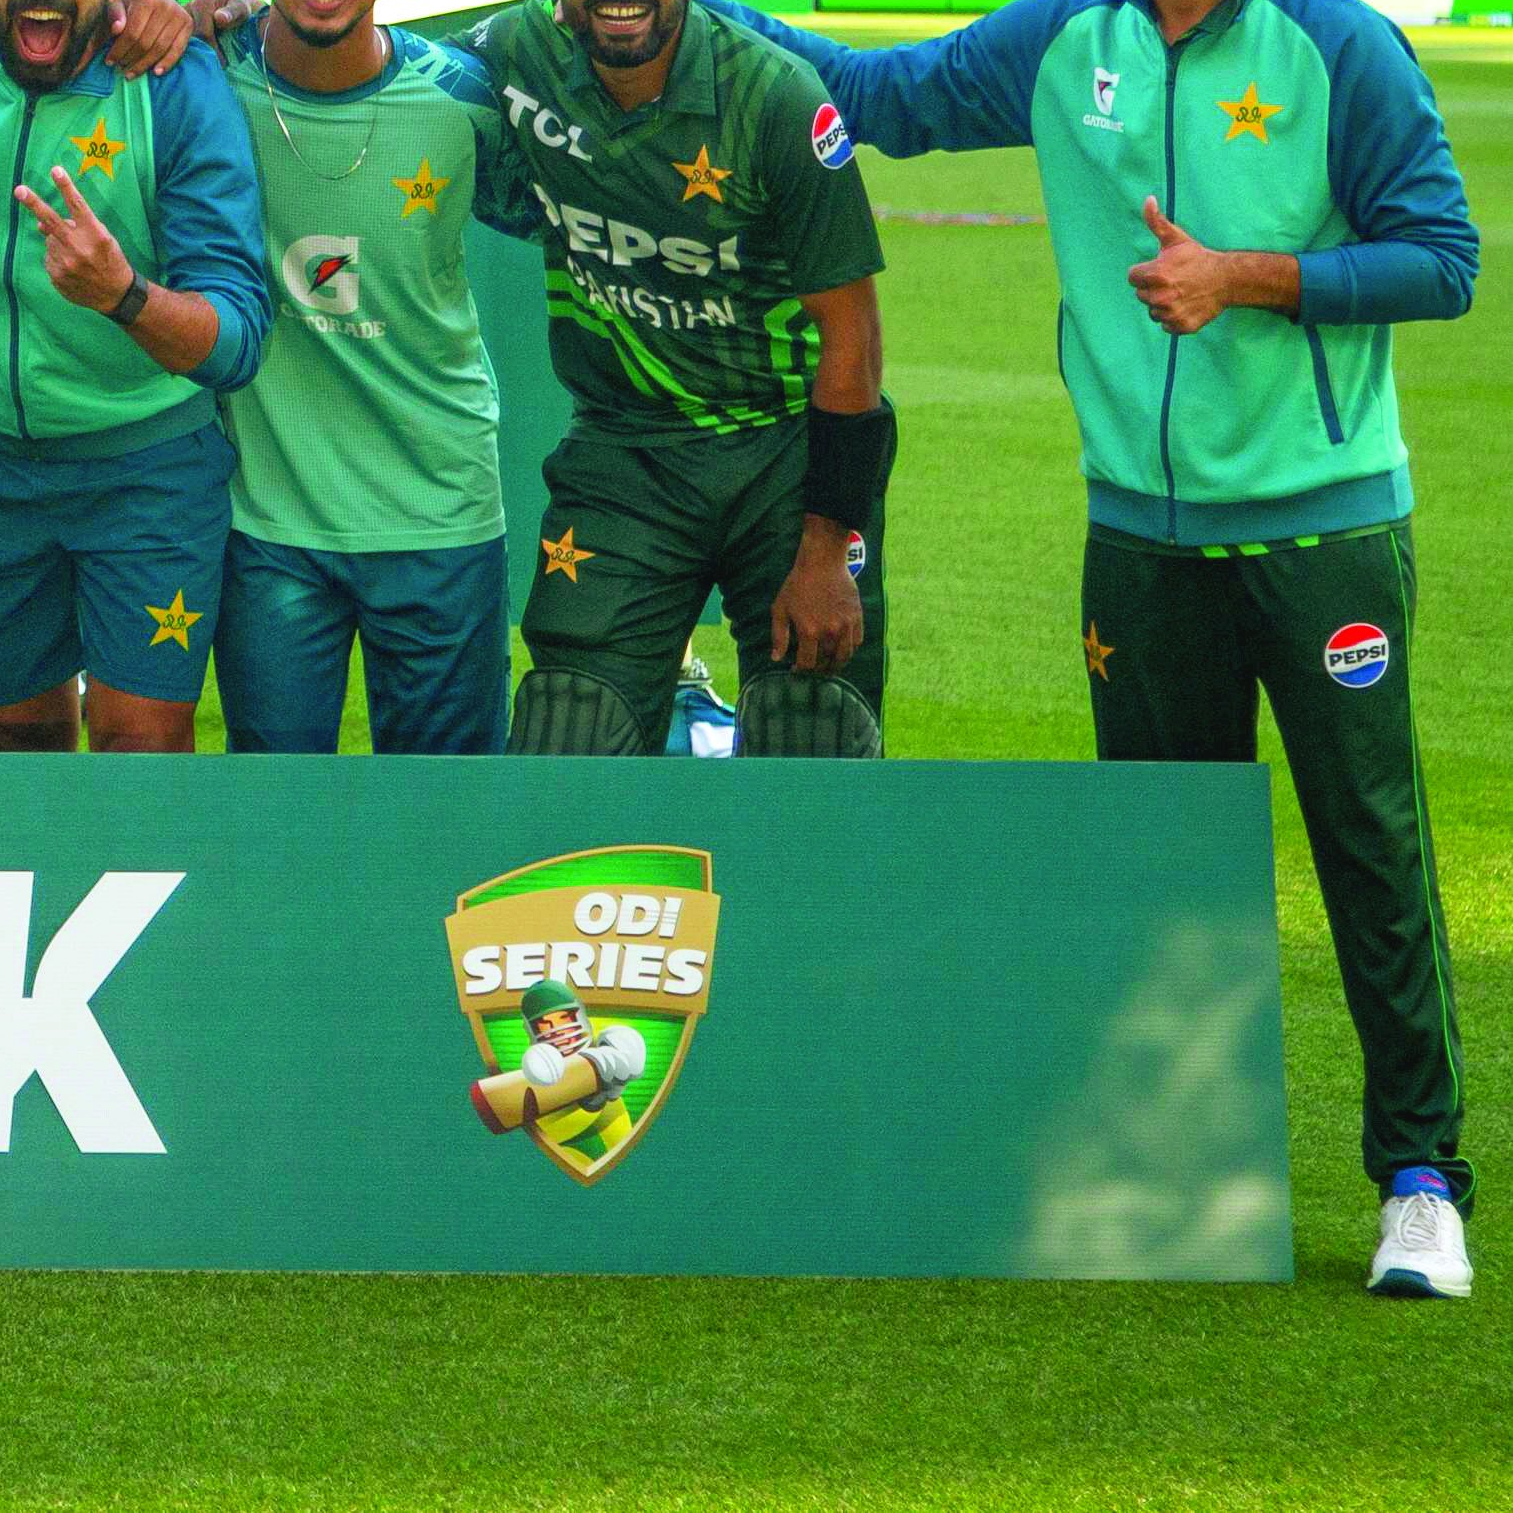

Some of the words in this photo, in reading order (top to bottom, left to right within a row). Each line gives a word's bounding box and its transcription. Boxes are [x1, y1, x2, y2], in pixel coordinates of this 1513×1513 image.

[1329, 643, 1387, 669] PEPSI
[573, 892, 683, 939] ODI
[462, 940, 709, 996] SERIES
